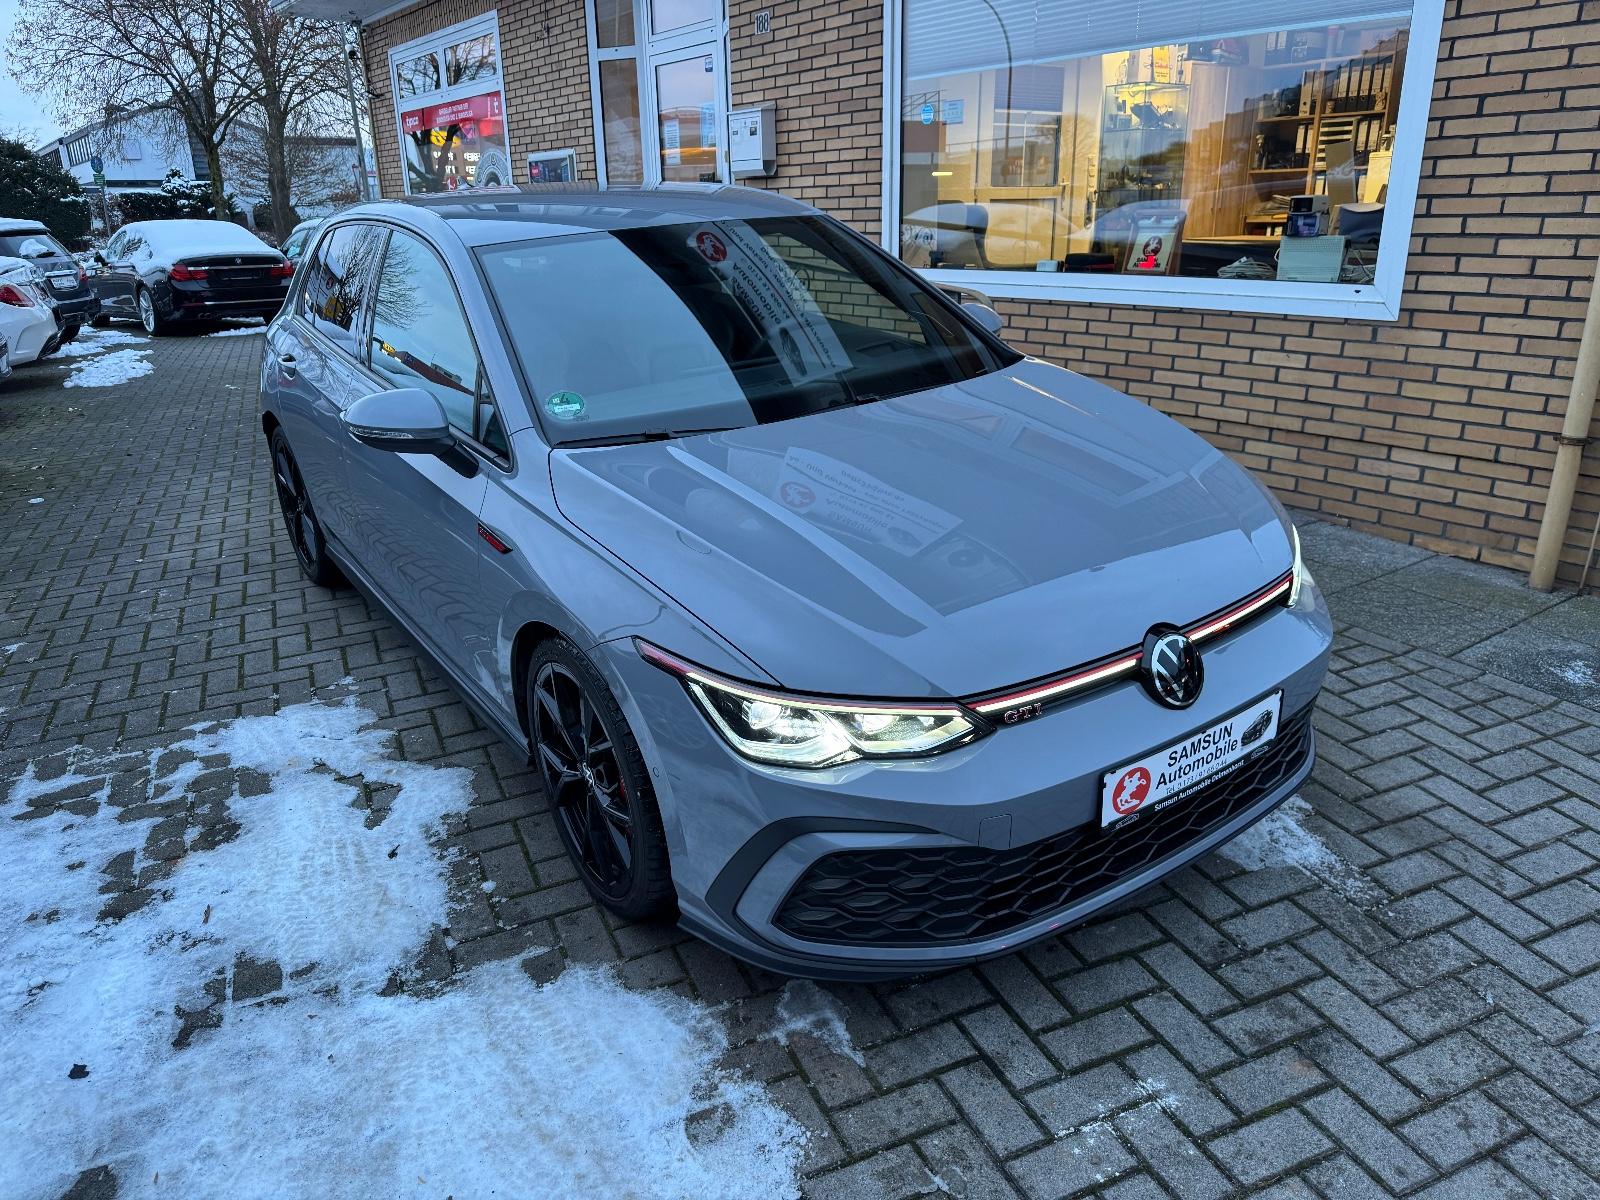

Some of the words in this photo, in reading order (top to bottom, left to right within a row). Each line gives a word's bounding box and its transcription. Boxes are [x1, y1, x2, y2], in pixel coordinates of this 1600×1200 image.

[756, 13, 769, 33] 188
[1004, 702, 1042, 724] GTI
[1167, 722, 1233, 768] SAMSUN
[1155, 739, 1238, 790] Automobile
[1154, 796, 1178, 812] Samsun
[1178, 778, 1211, 800] Automobile
